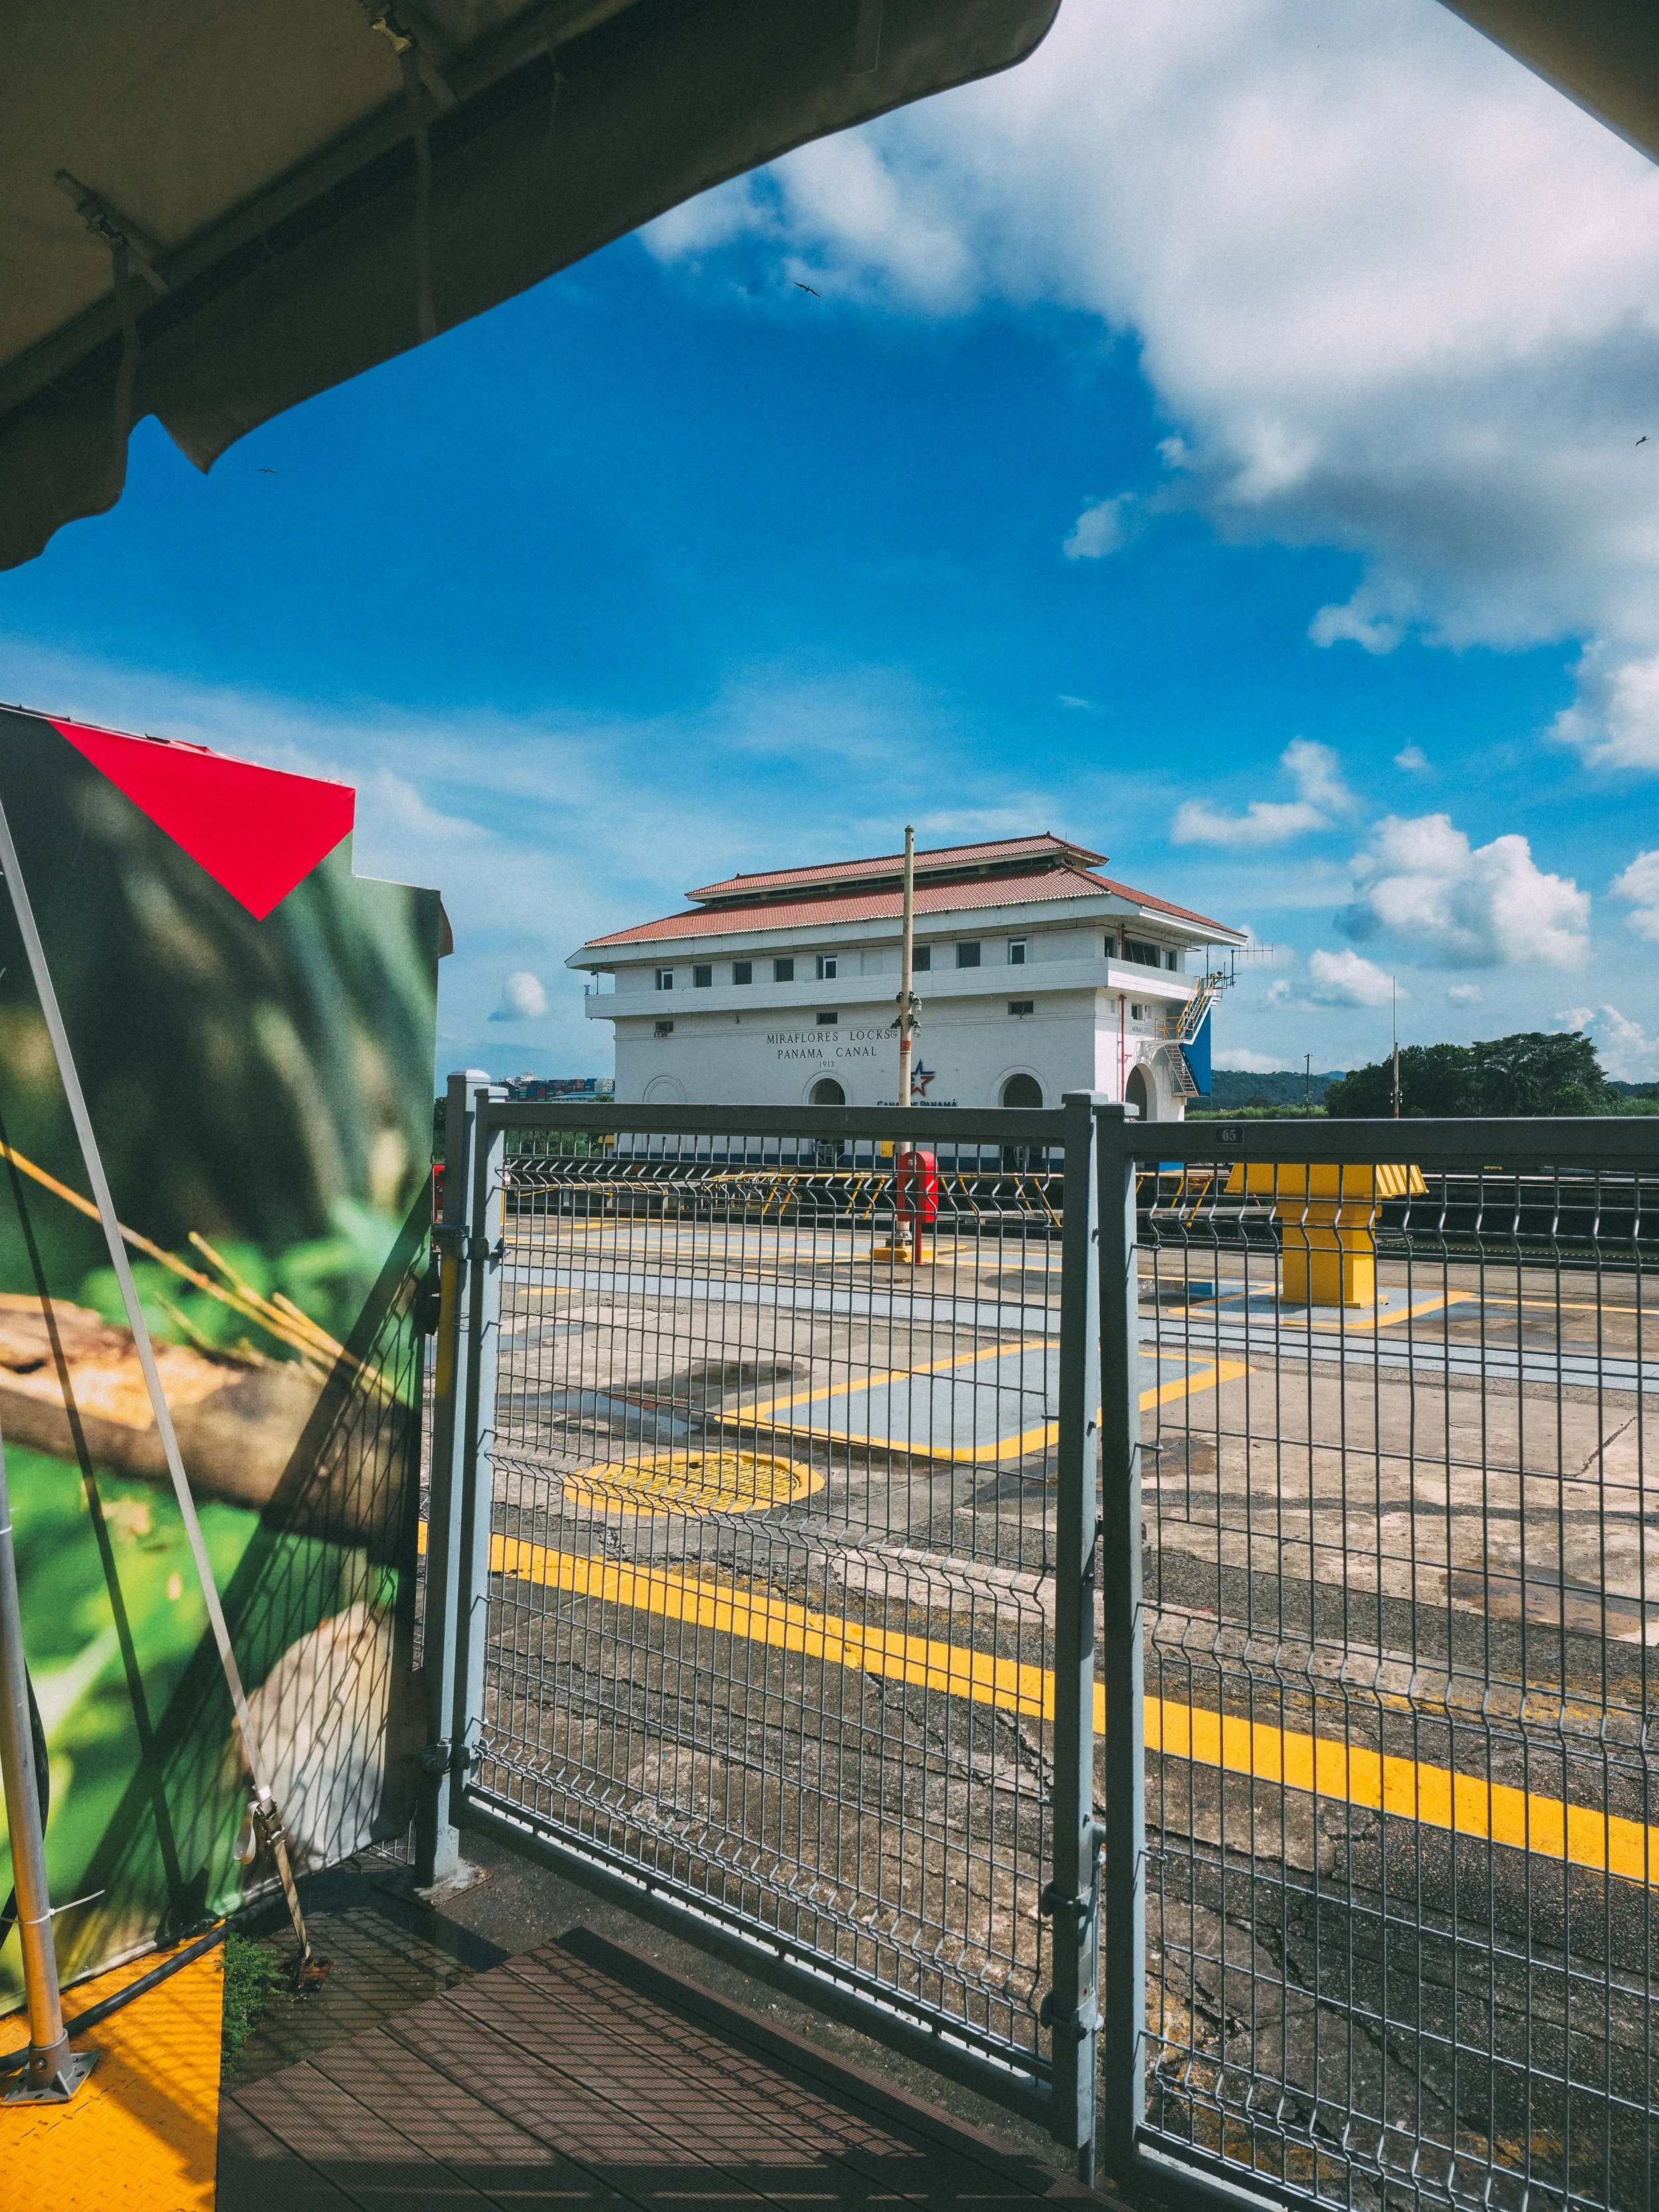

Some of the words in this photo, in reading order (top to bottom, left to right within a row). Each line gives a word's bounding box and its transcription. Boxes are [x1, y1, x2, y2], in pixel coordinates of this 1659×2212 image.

[767, 1032, 839, 1044] MIRAFLORES
[850, 1029, 891, 1041] LOCKS
[778, 1049, 823, 1059] PANAMA
[836, 1047, 877, 1057] CANAL
[1222, 1129, 1236, 1142] 65
